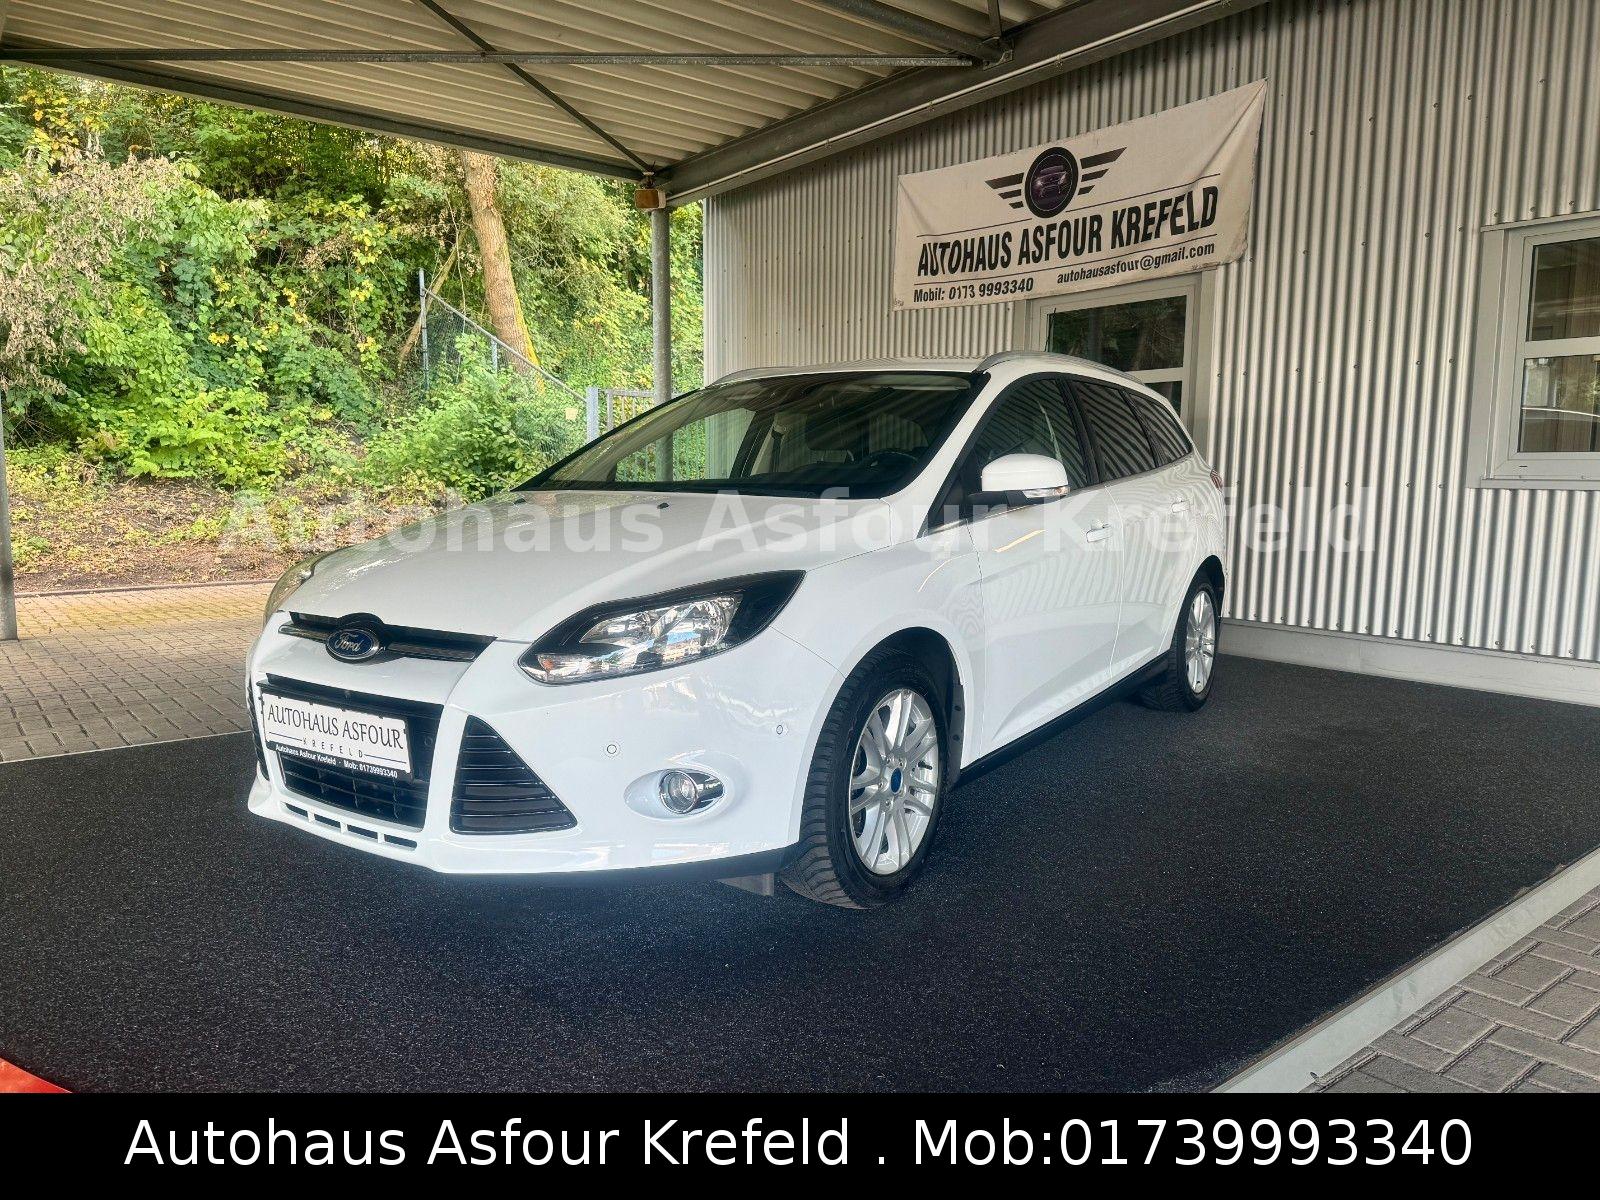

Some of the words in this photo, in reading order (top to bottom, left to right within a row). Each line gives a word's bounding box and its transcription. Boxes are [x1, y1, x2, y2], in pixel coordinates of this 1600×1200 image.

[917, 230, 1012, 277] AUTOHAUS
[1017, 214, 1102, 266] ASFOUR
[1110, 185, 1219, 250] KREFELD
[1056, 242, 1215, 284] autohausasfour@gmail.com
[913, 287, 945, 303] Mobil:
[948, 285, 975, 300] 0173
[978, 277, 1034, 297] 9993340
[334, 632, 363, 652] Ford
[267, 703, 339, 737] AUTOHAUS
[342, 719, 404, 750] ASFOUR
[302, 737, 364, 759] KREFELD
